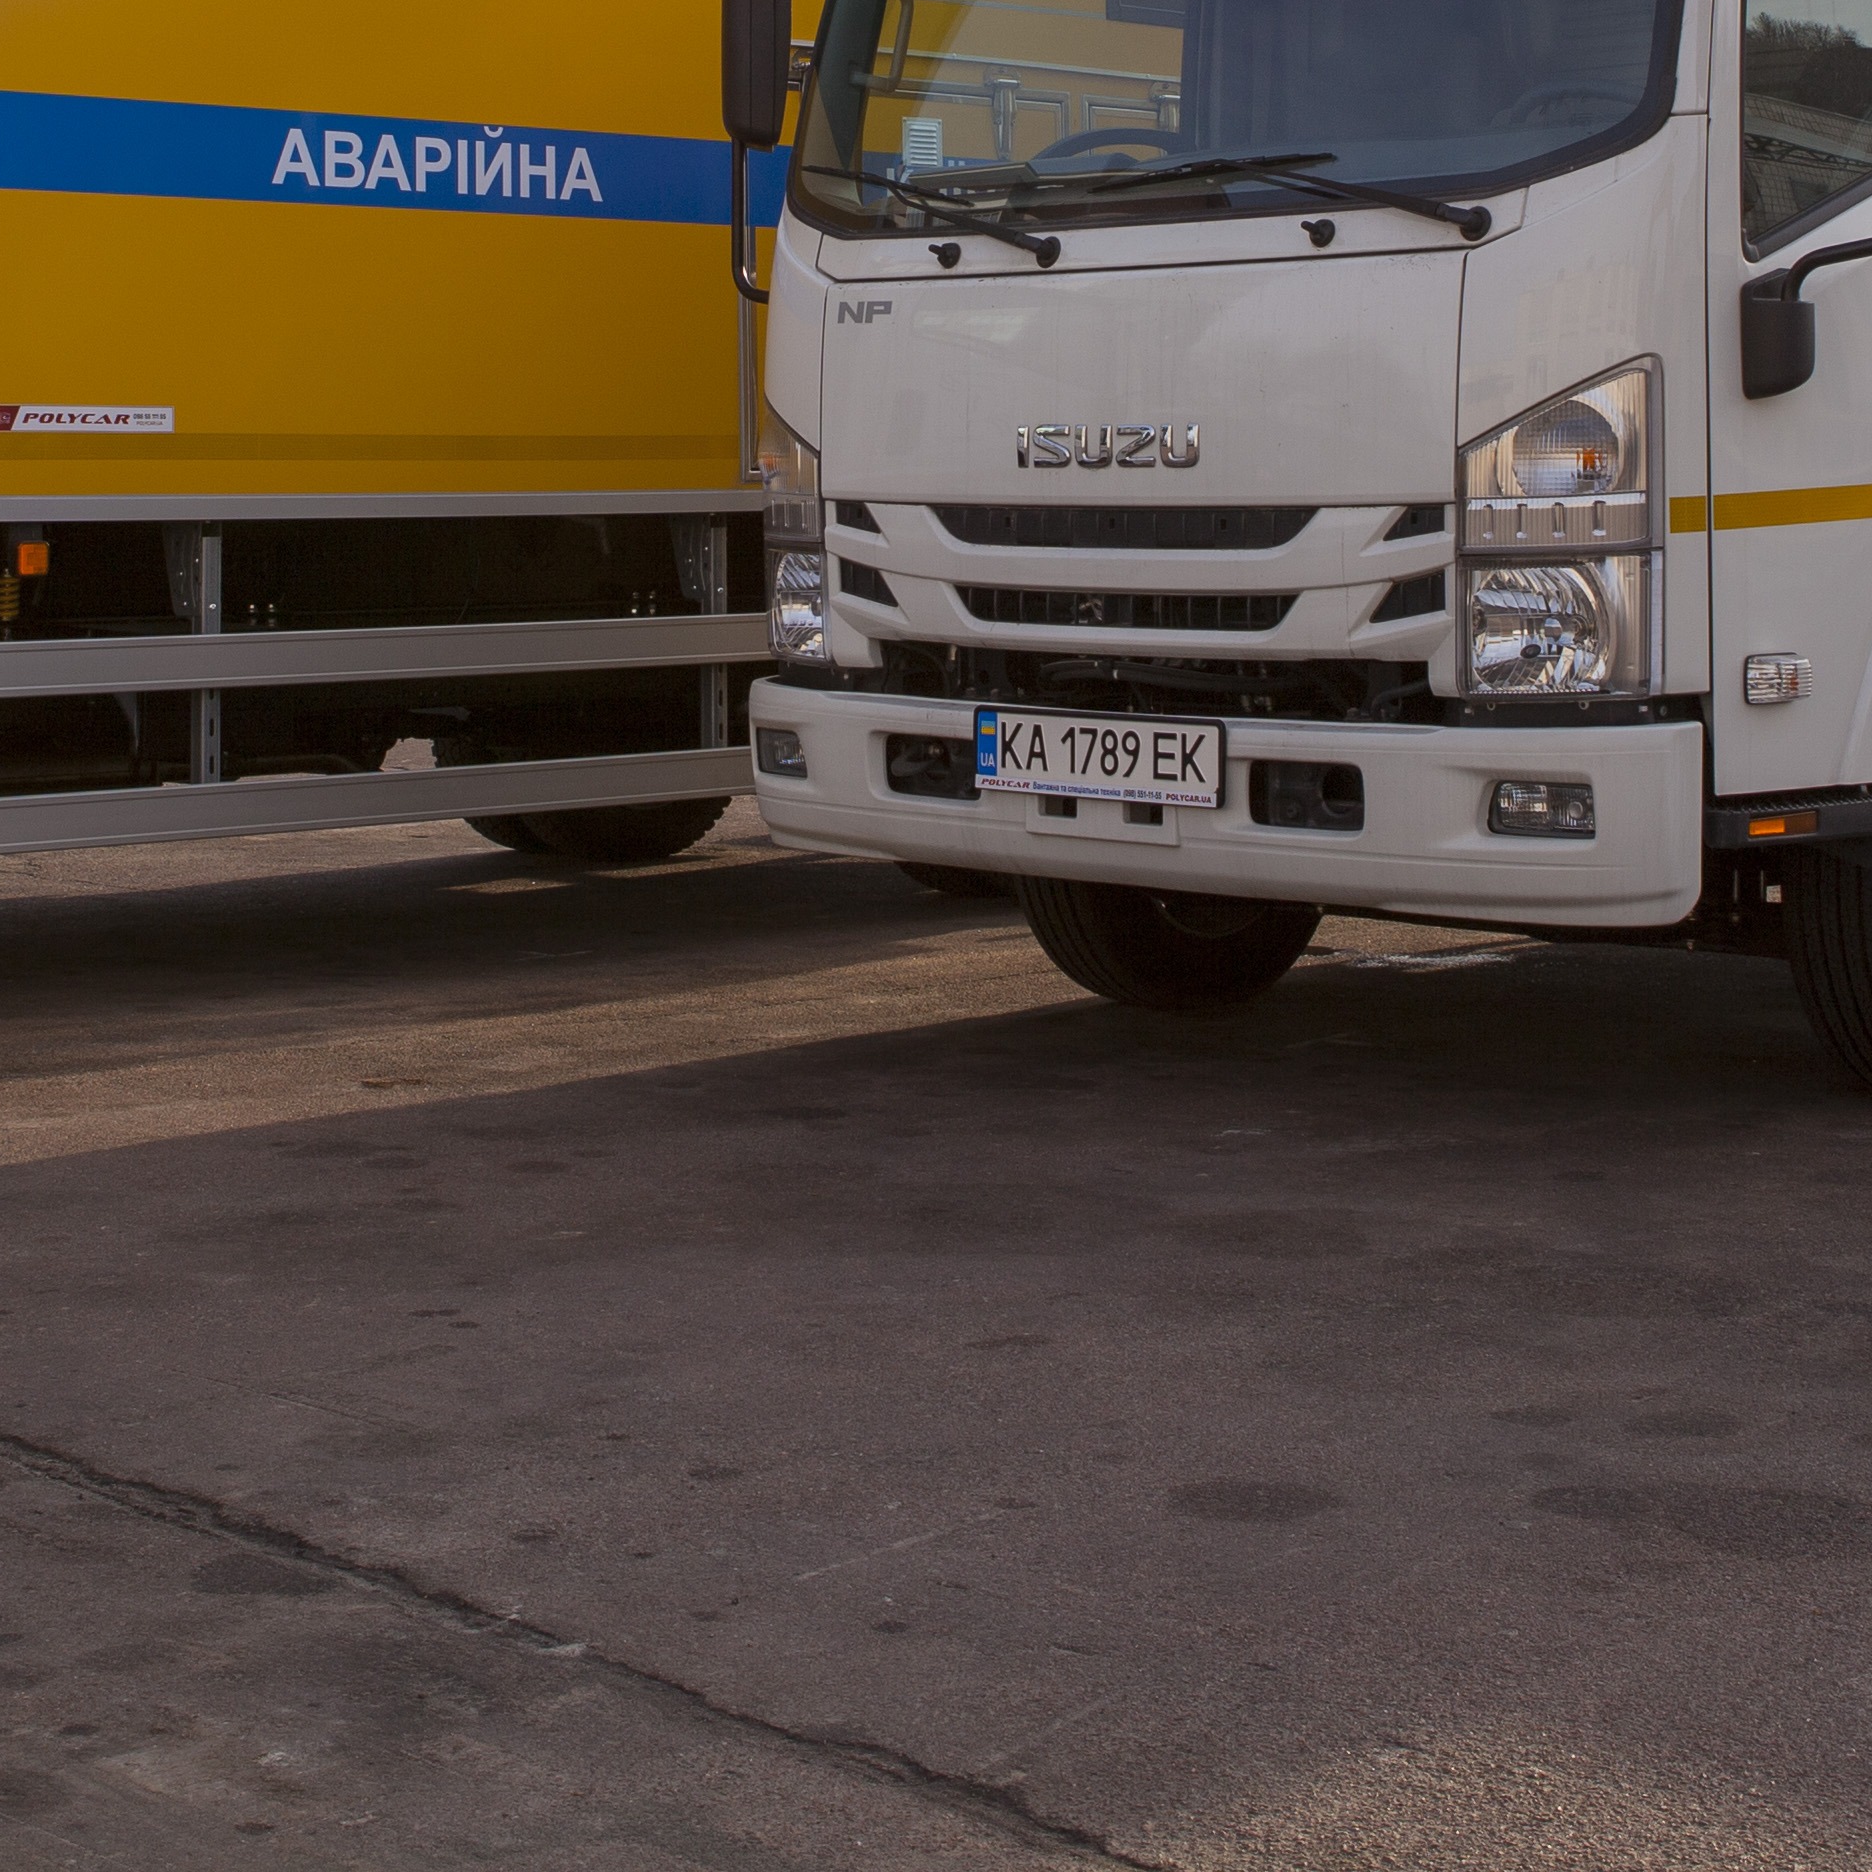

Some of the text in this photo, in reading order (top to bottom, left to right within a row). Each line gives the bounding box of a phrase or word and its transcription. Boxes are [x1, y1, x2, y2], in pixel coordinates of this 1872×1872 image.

[271, 125, 603, 203] АВАРІЙНА
[837, 300, 893, 324] NP
[22, 412, 130, 425] POLYCAR
[1016, 423, 1200, 468] ISUZU
[980, 752, 996, 767] UA
[1000, 721, 1207, 783] KA 1789 EK
[981, 778, 1030, 789] POLYCAR
